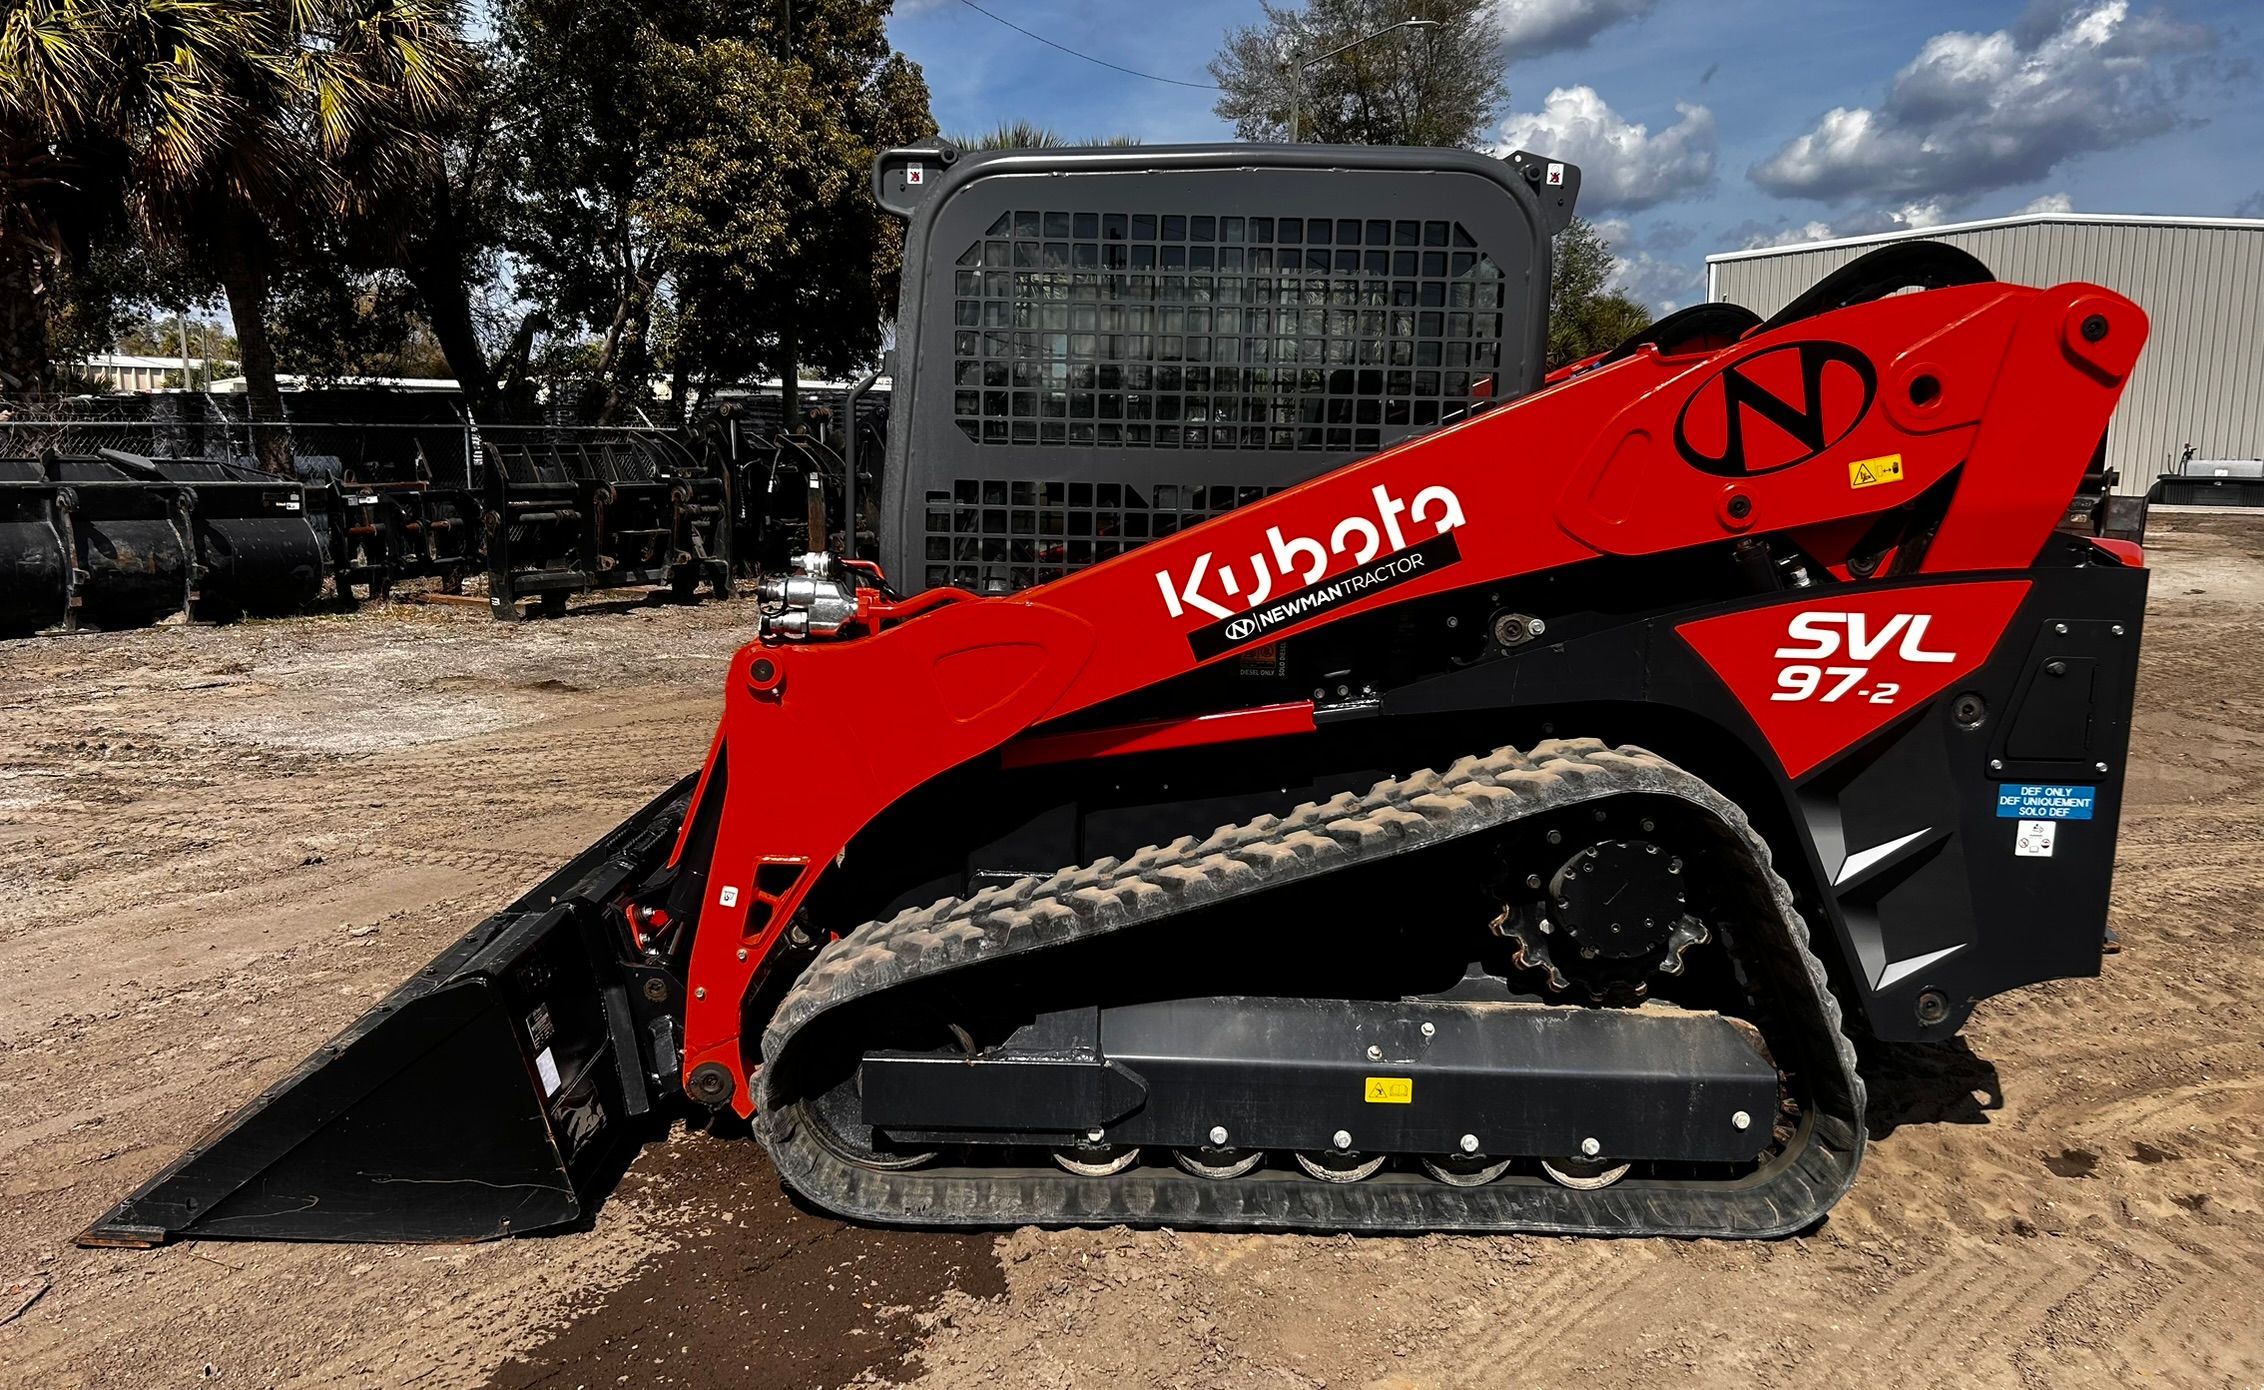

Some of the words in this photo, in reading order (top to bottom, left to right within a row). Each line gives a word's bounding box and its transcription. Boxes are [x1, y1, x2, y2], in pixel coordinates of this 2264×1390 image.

[1155, 484, 1466, 620] Kubota
[1774, 611, 1956, 663] SVL
[2021, 787, 2042, 796] DEF
[2045, 787, 2073, 797] ONLY
[2000, 796, 2021, 806] DEF
[2023, 797, 2091, 807] UNIQUEMENT
[2019, 807, 2047, 816] SOLO
[2048, 808, 2070, 817] DEF
